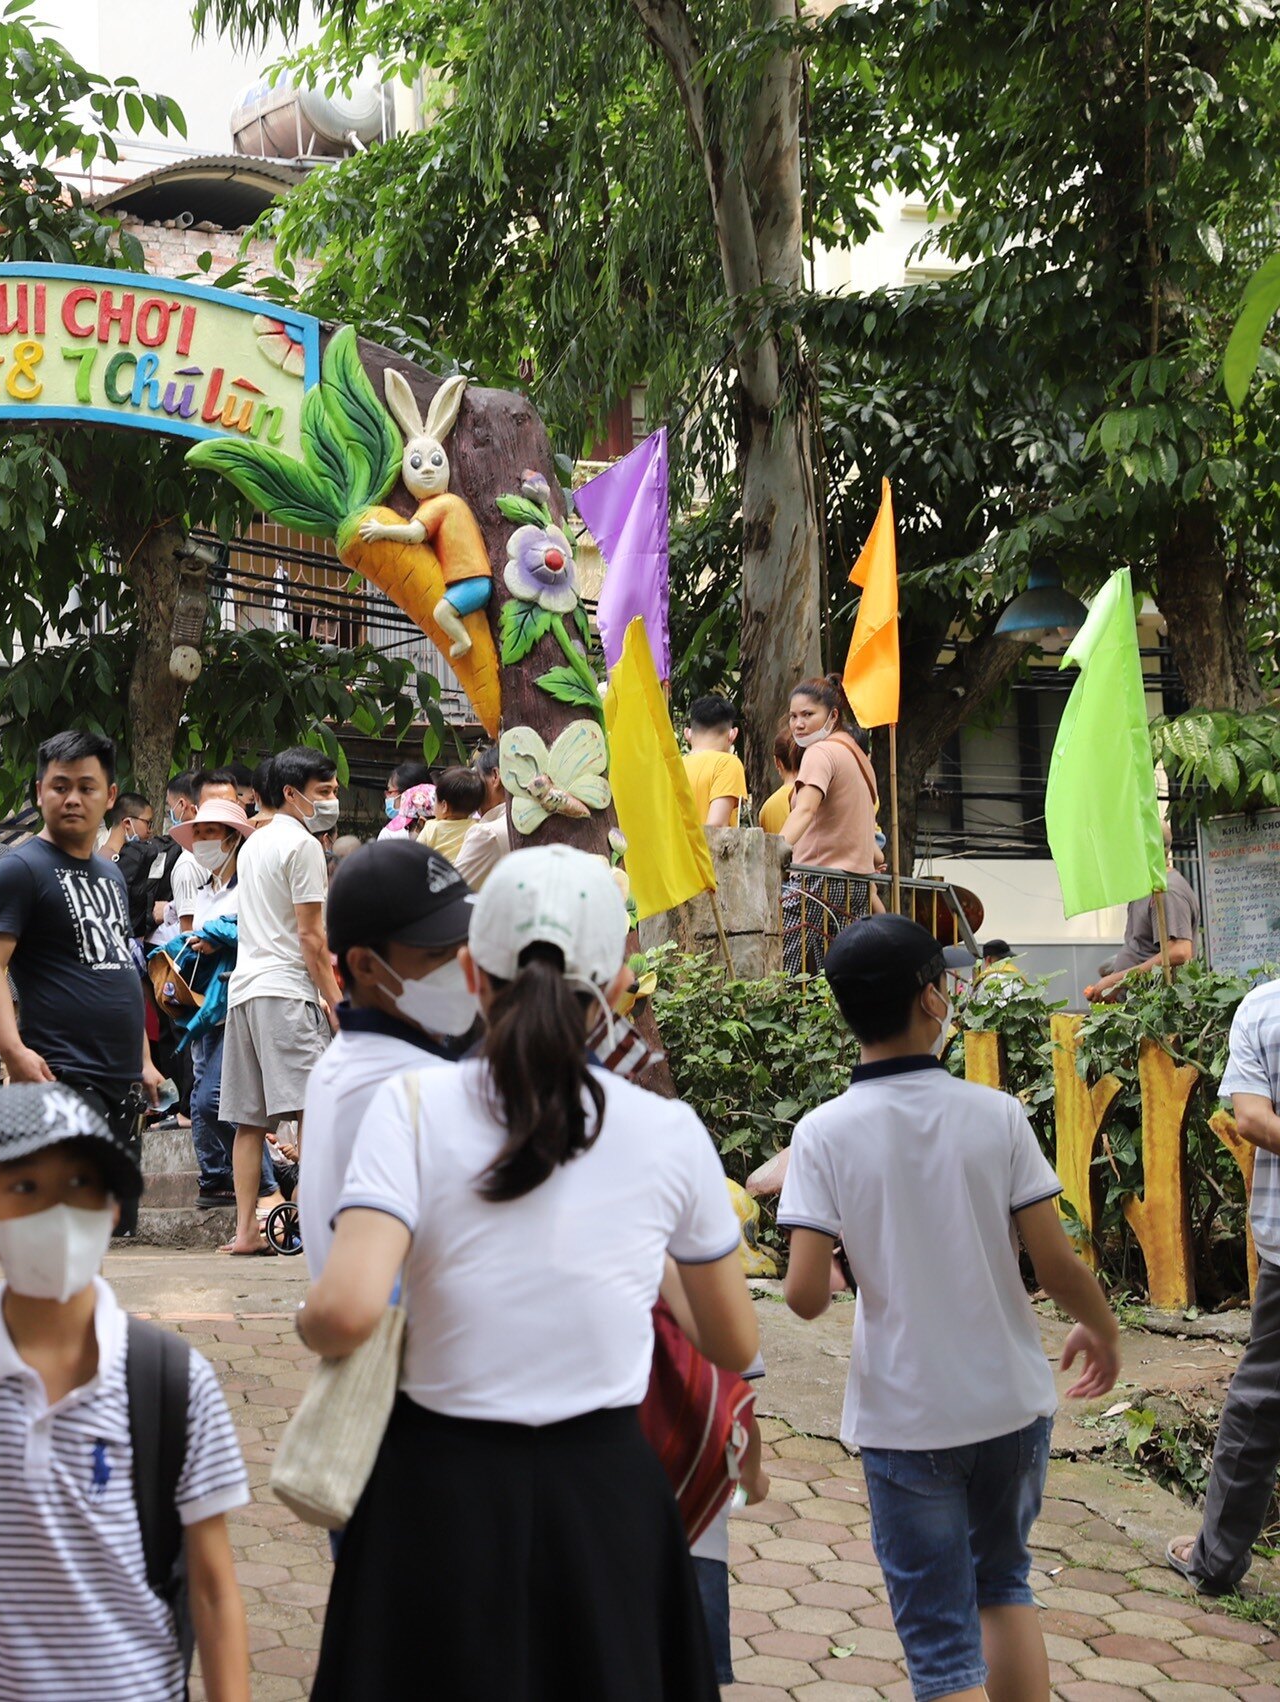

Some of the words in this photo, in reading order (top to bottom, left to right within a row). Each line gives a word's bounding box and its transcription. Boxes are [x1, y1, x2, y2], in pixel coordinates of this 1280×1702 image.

[61, 286, 197, 356] CHƠI
[6, 340, 44, 400] &
[61, 346, 98, 403] 7
[104, 350, 204, 419] Chú
